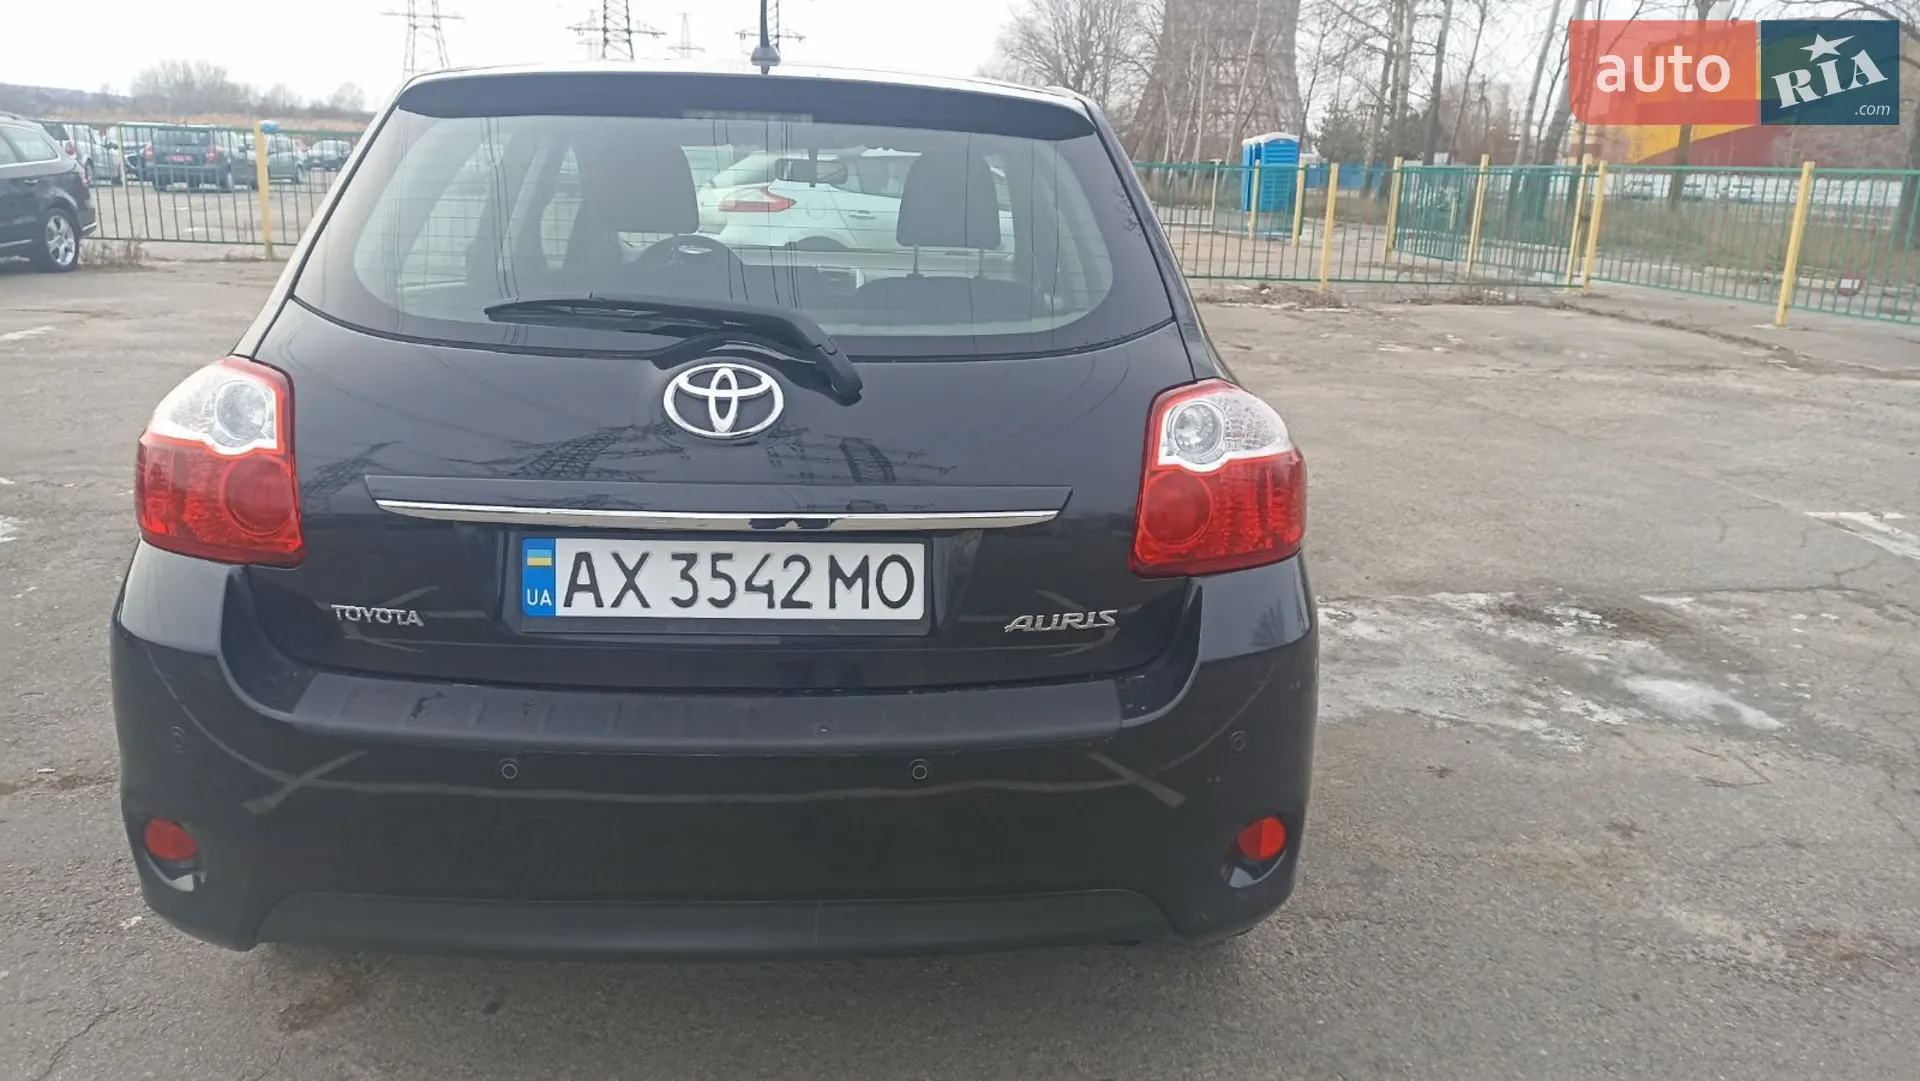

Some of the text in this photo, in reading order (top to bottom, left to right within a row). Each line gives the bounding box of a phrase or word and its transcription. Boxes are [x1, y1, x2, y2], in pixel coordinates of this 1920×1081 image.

[563, 551, 915, 610] AX 3542 MO
[527, 589, 552, 606] UA
[331, 604, 424, 627] TOYOTA
[1004, 609, 1118, 633] AURIS
